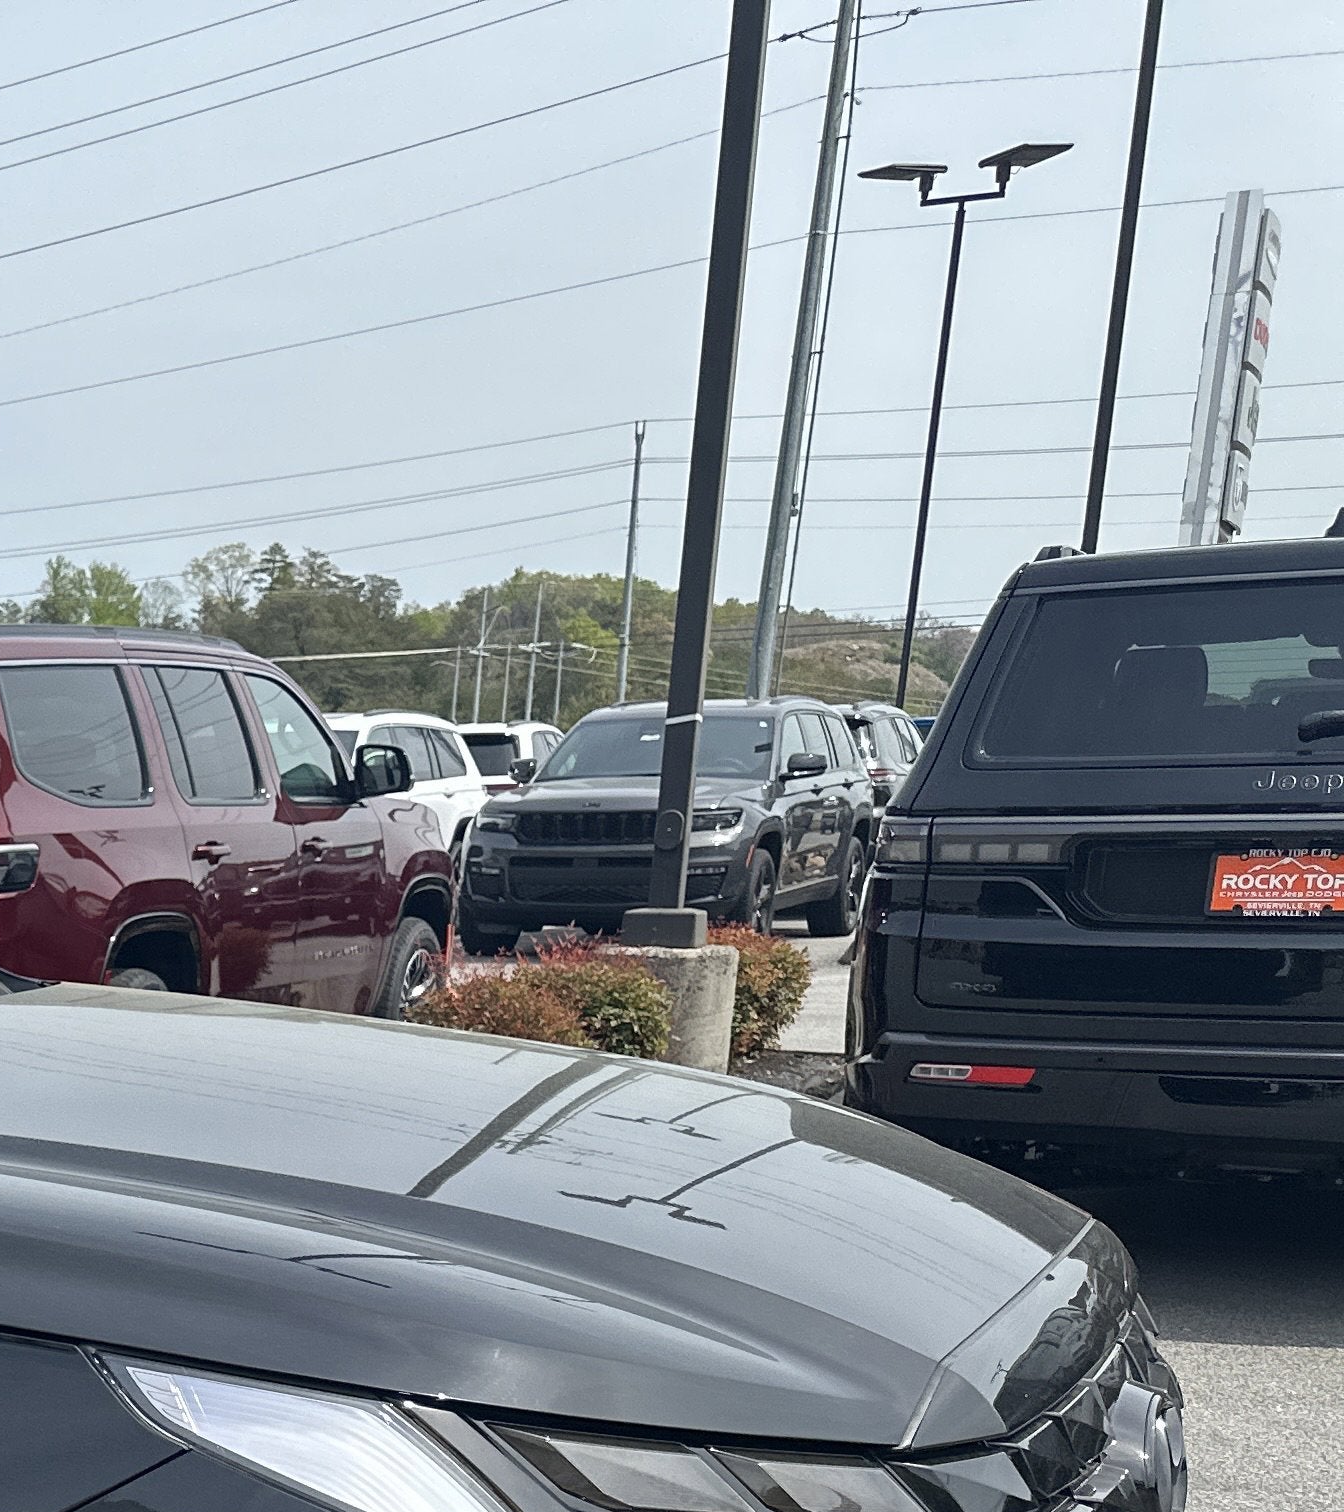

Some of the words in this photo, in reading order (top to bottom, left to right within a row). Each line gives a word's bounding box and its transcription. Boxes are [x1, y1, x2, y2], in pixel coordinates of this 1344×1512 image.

[1252, 770, 1344, 794] Jeep
[1249, 848, 1284, 858] ROCKY
[1288, 848, 1309, 858] TOP
[1221, 874, 1300, 890] ROCKY
[1303, 874, 1344, 890] TOP
[1281, 890, 1304, 898] Jeep
